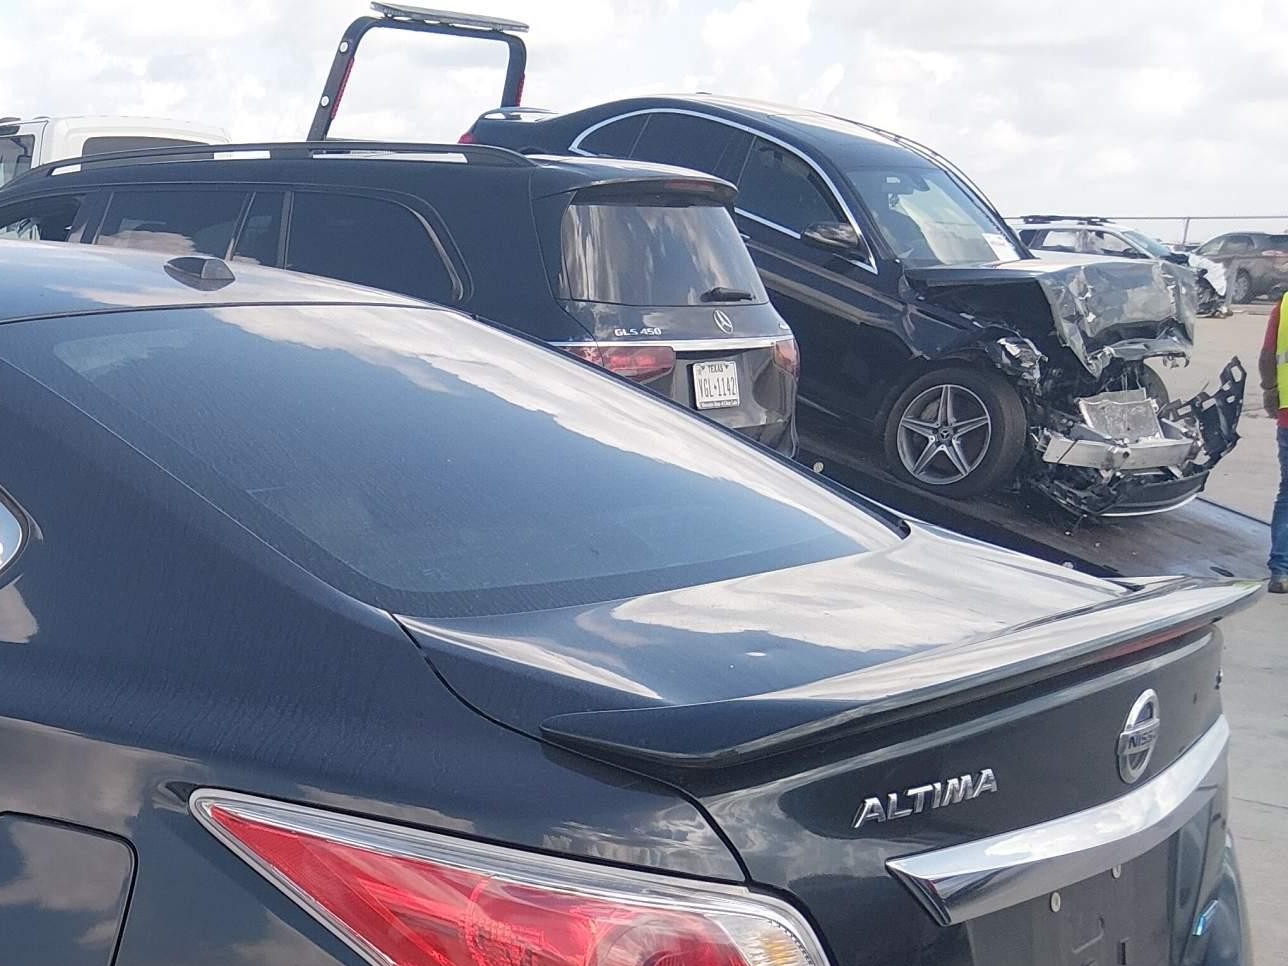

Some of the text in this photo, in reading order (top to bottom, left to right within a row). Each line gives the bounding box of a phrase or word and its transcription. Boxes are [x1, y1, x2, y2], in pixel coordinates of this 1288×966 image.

[614, 327, 662, 337] GLS 450
[708, 363, 723, 372] TEXAS
[852, 768, 998, 828] ALTIMA
